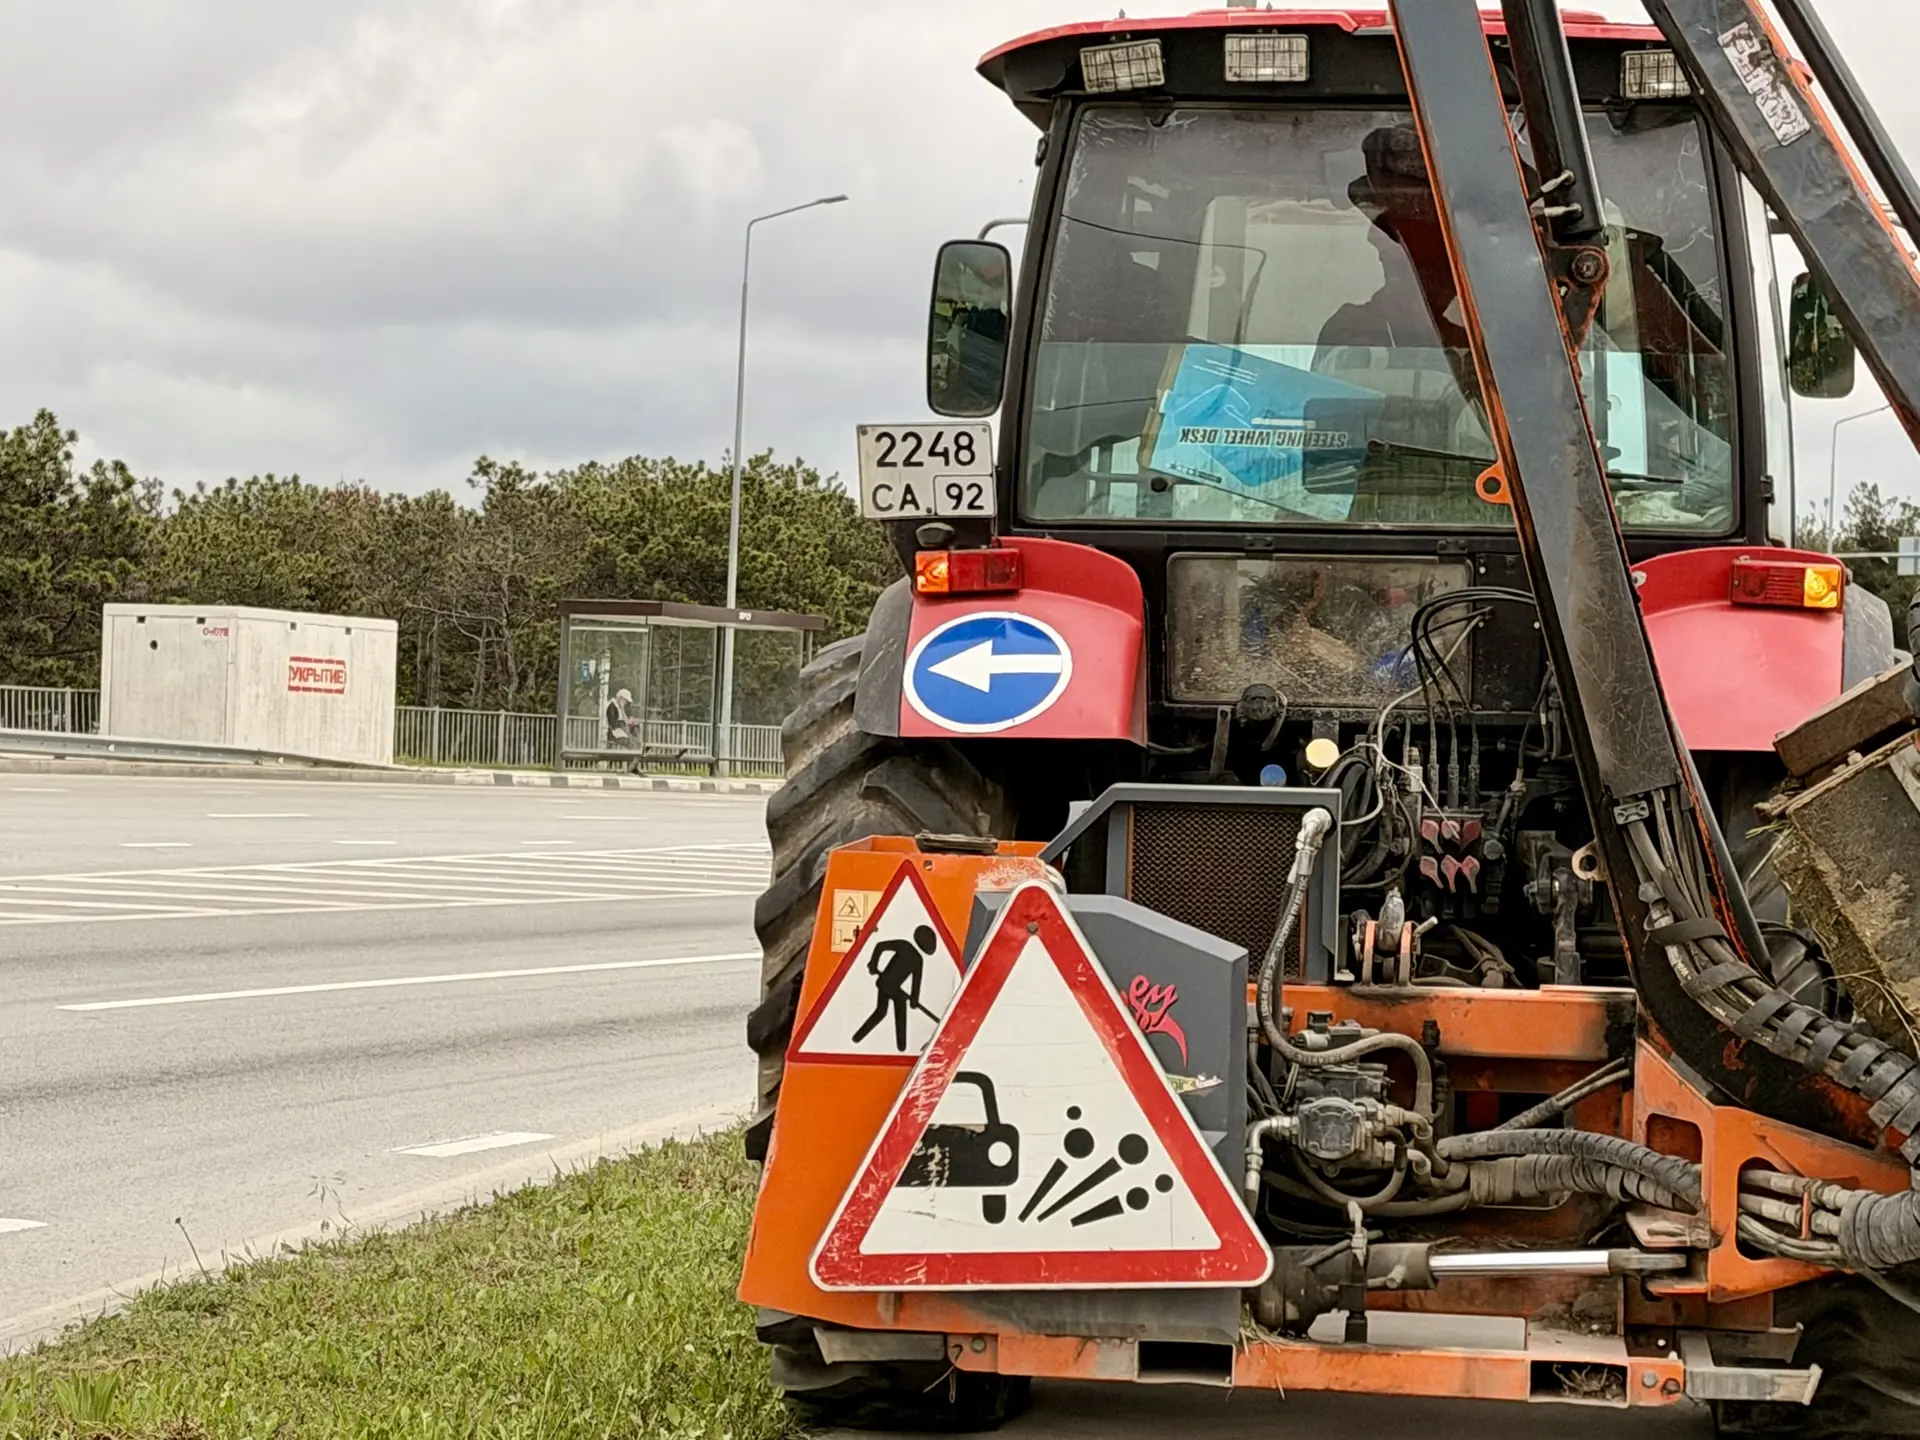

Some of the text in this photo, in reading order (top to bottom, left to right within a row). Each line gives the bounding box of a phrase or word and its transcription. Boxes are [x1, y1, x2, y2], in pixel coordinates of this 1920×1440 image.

[875, 431, 976, 467] 2248
[1179, 428, 1347, 448] STEERING WHEEL DESK
[945, 483, 984, 510] 92
[292, 665, 344, 684] УКРЫТИЕ
